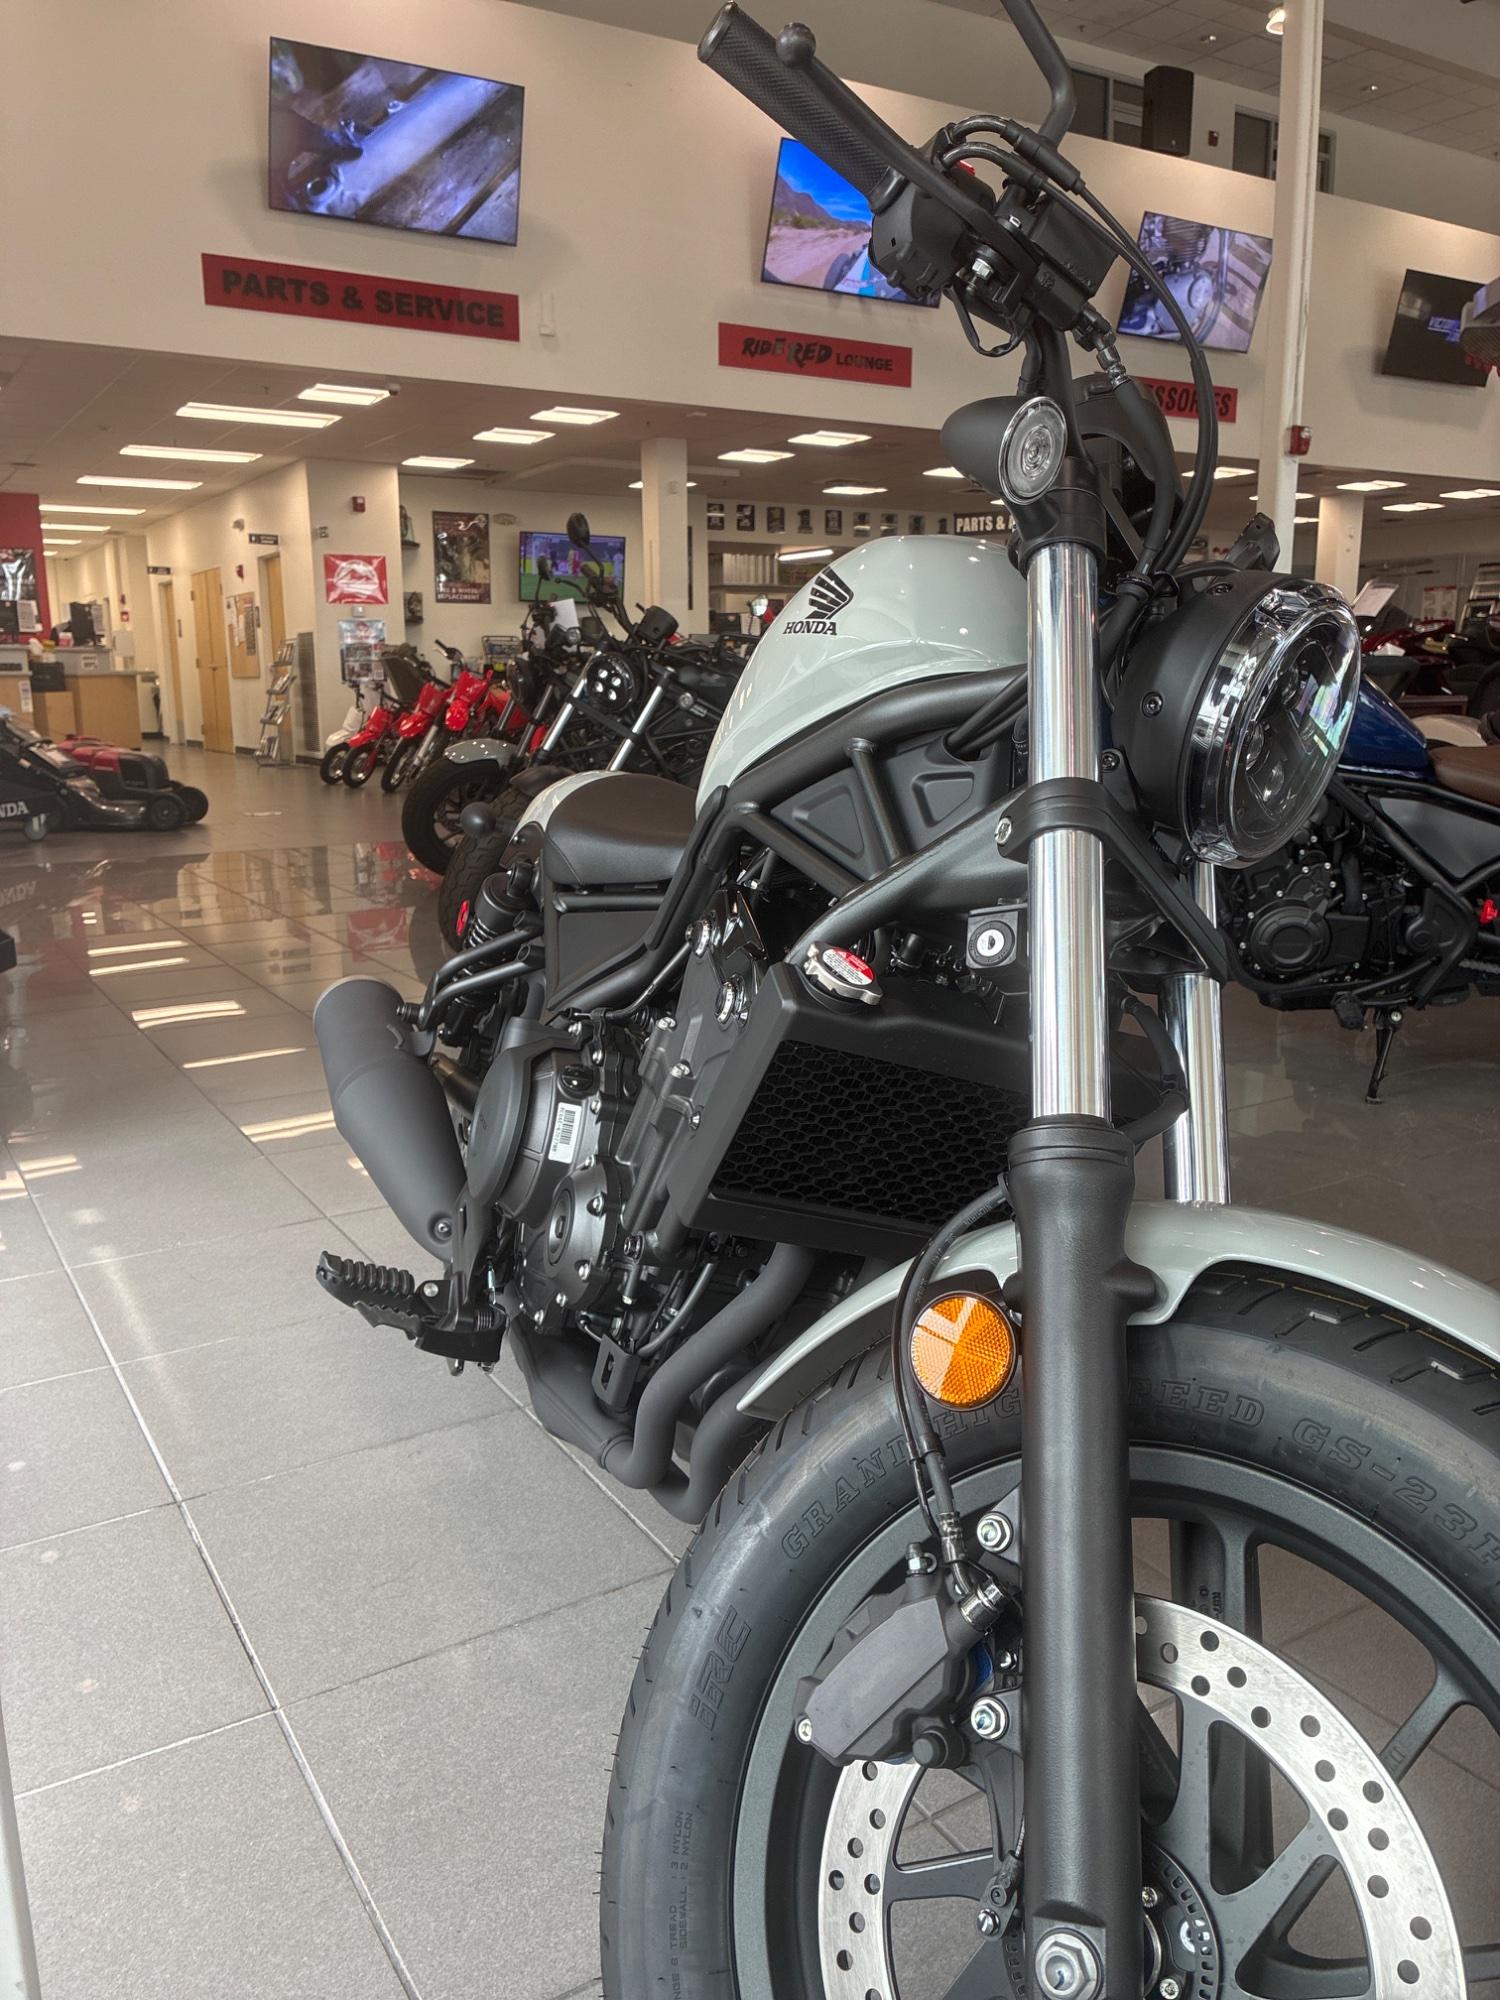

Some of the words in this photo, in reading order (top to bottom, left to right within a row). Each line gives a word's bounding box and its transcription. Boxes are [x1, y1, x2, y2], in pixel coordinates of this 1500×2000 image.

[221, 268, 330, 306] PARTS
[342, 285, 364, 311] &
[374, 289, 505, 328] SERVICE
[741, 337, 786, 358] RIDE
[786, 341, 832, 369] RED
[836, 352, 893, 372] LOUNGE
[956, 516, 993, 533] PARTS
[995, 515, 1006, 530] &
[782, 620, 837, 636] HONDA
[932, 1388, 1022, 1442] HIG
[1127, 1376, 1264, 1429] PEED
[671, 1811, 683, 1855] NYLON
[681, 1811, 693, 1856] NYLON
